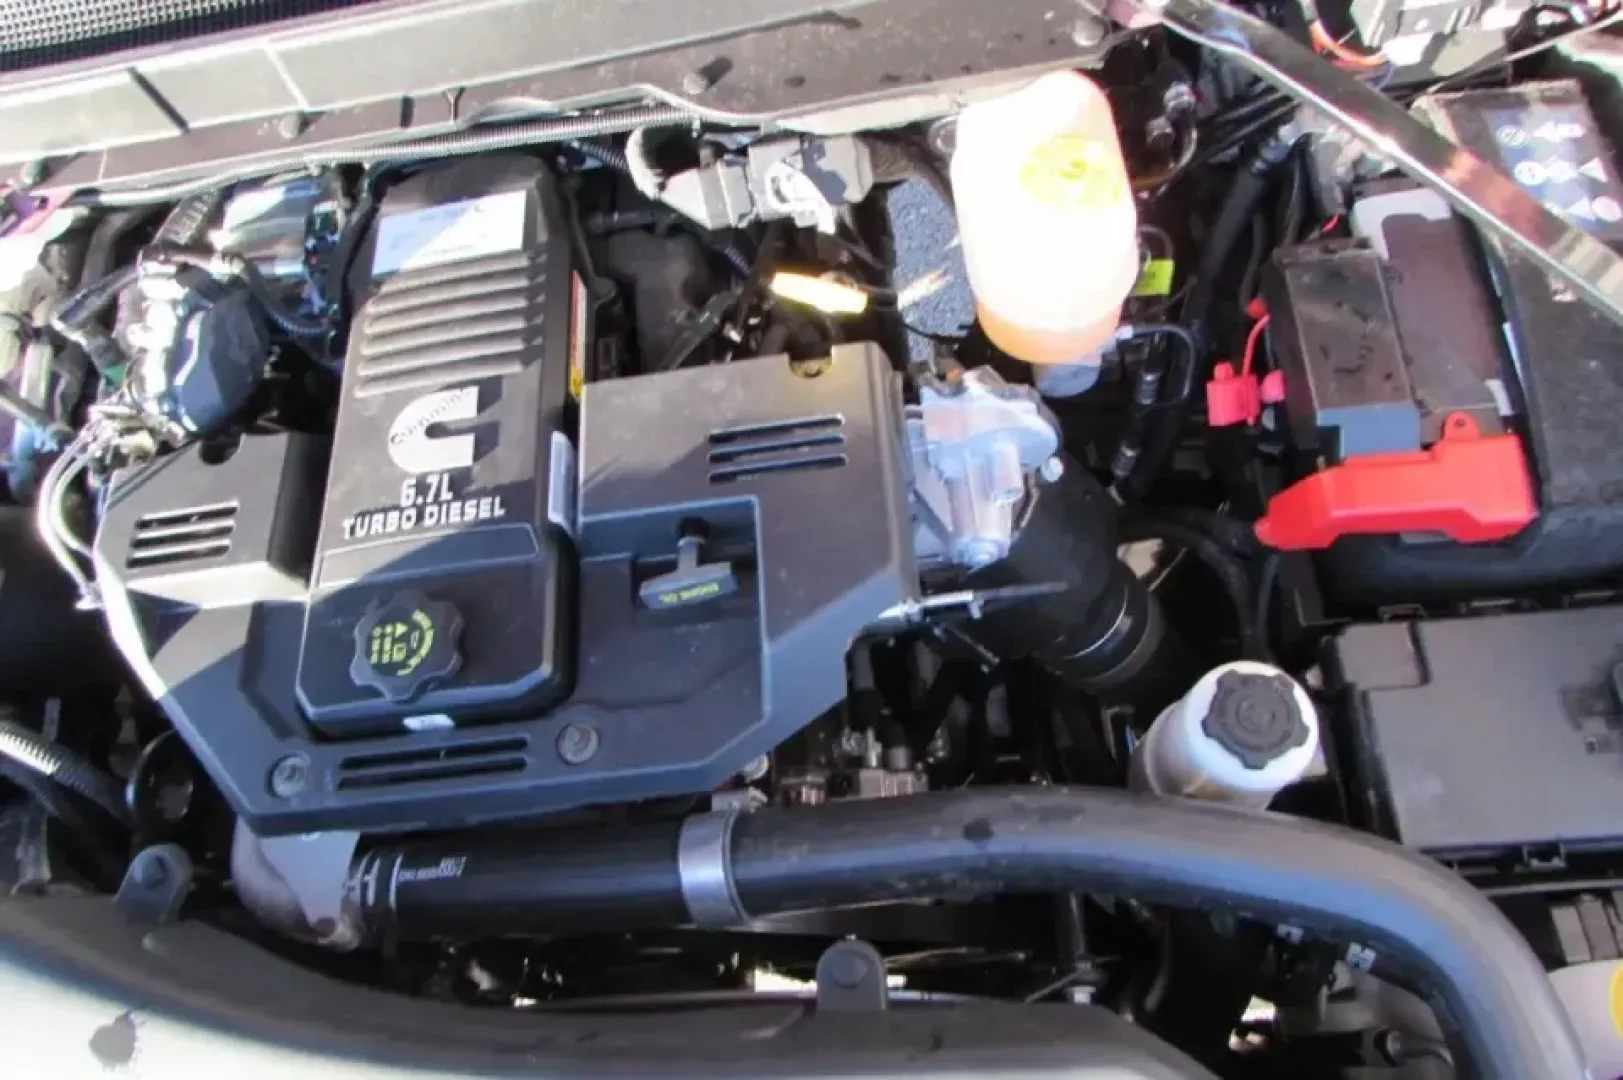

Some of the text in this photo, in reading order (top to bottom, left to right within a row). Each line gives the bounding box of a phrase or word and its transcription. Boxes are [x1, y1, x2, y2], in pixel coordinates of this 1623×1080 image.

[400, 472, 454, 508] 6.7L
[342, 495, 506, 541] TURBO DIESEL
